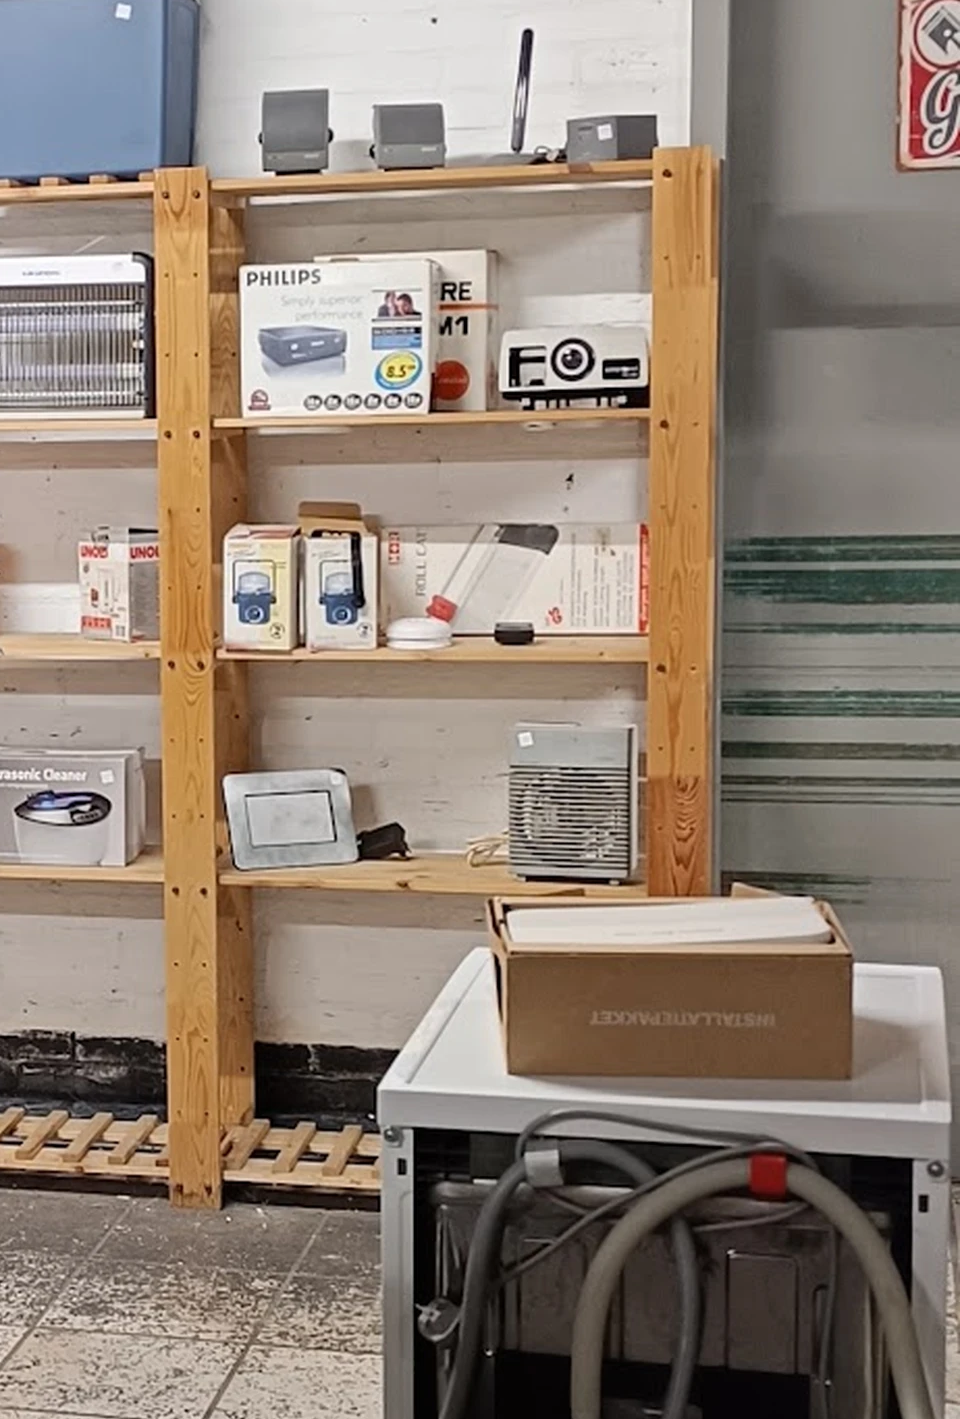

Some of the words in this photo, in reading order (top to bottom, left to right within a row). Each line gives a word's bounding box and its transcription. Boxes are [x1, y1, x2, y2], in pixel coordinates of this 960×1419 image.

[246, 269, 321, 286] PHILIPS
[416, 562, 426, 597] ROLL
[43, 768, 87, 782] Cleaner
[591, 1010, 777, 1027] INSTALLATIEPAKKET
